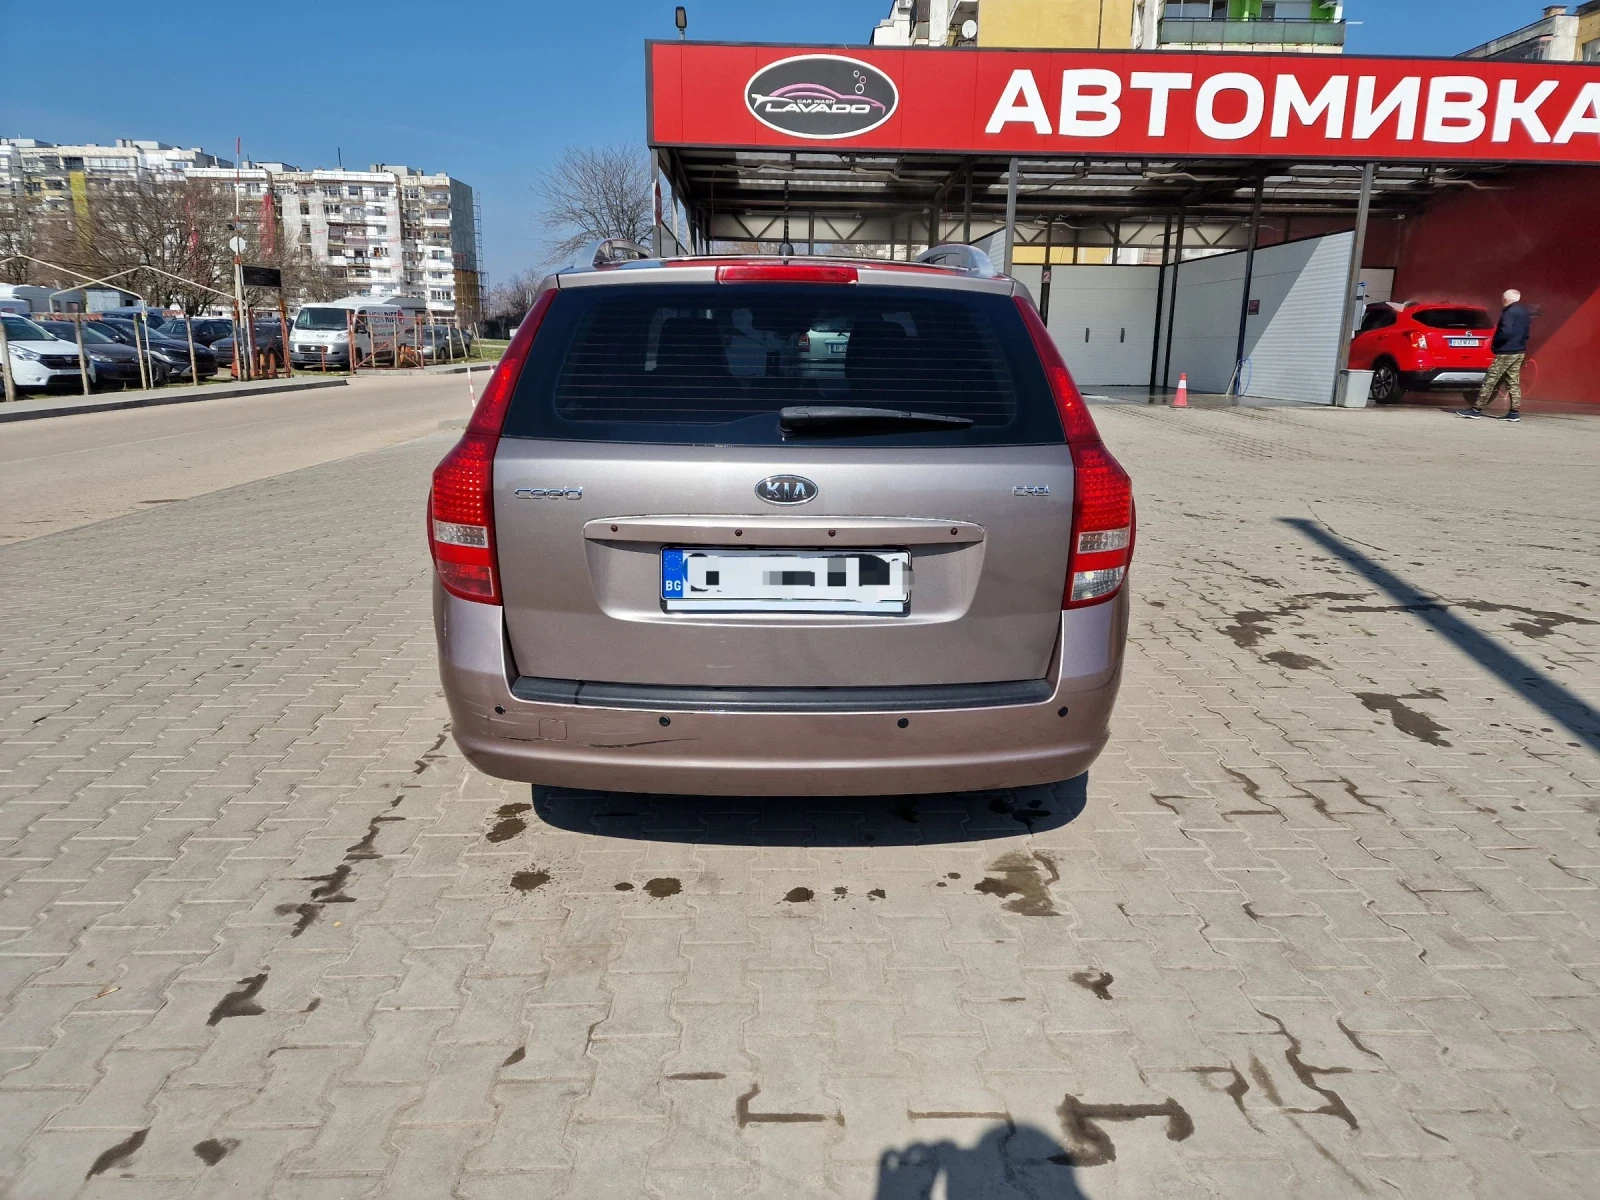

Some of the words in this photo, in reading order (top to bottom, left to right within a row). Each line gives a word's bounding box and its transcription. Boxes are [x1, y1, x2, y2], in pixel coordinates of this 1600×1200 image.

[765, 103, 871, 113] LAVADO
[985, 68, 1600, 144] АВТОМИВКА
[1043, 271, 1051, 282] 2
[765, 481, 809, 499] KIA
[665, 579, 682, 592] BG
